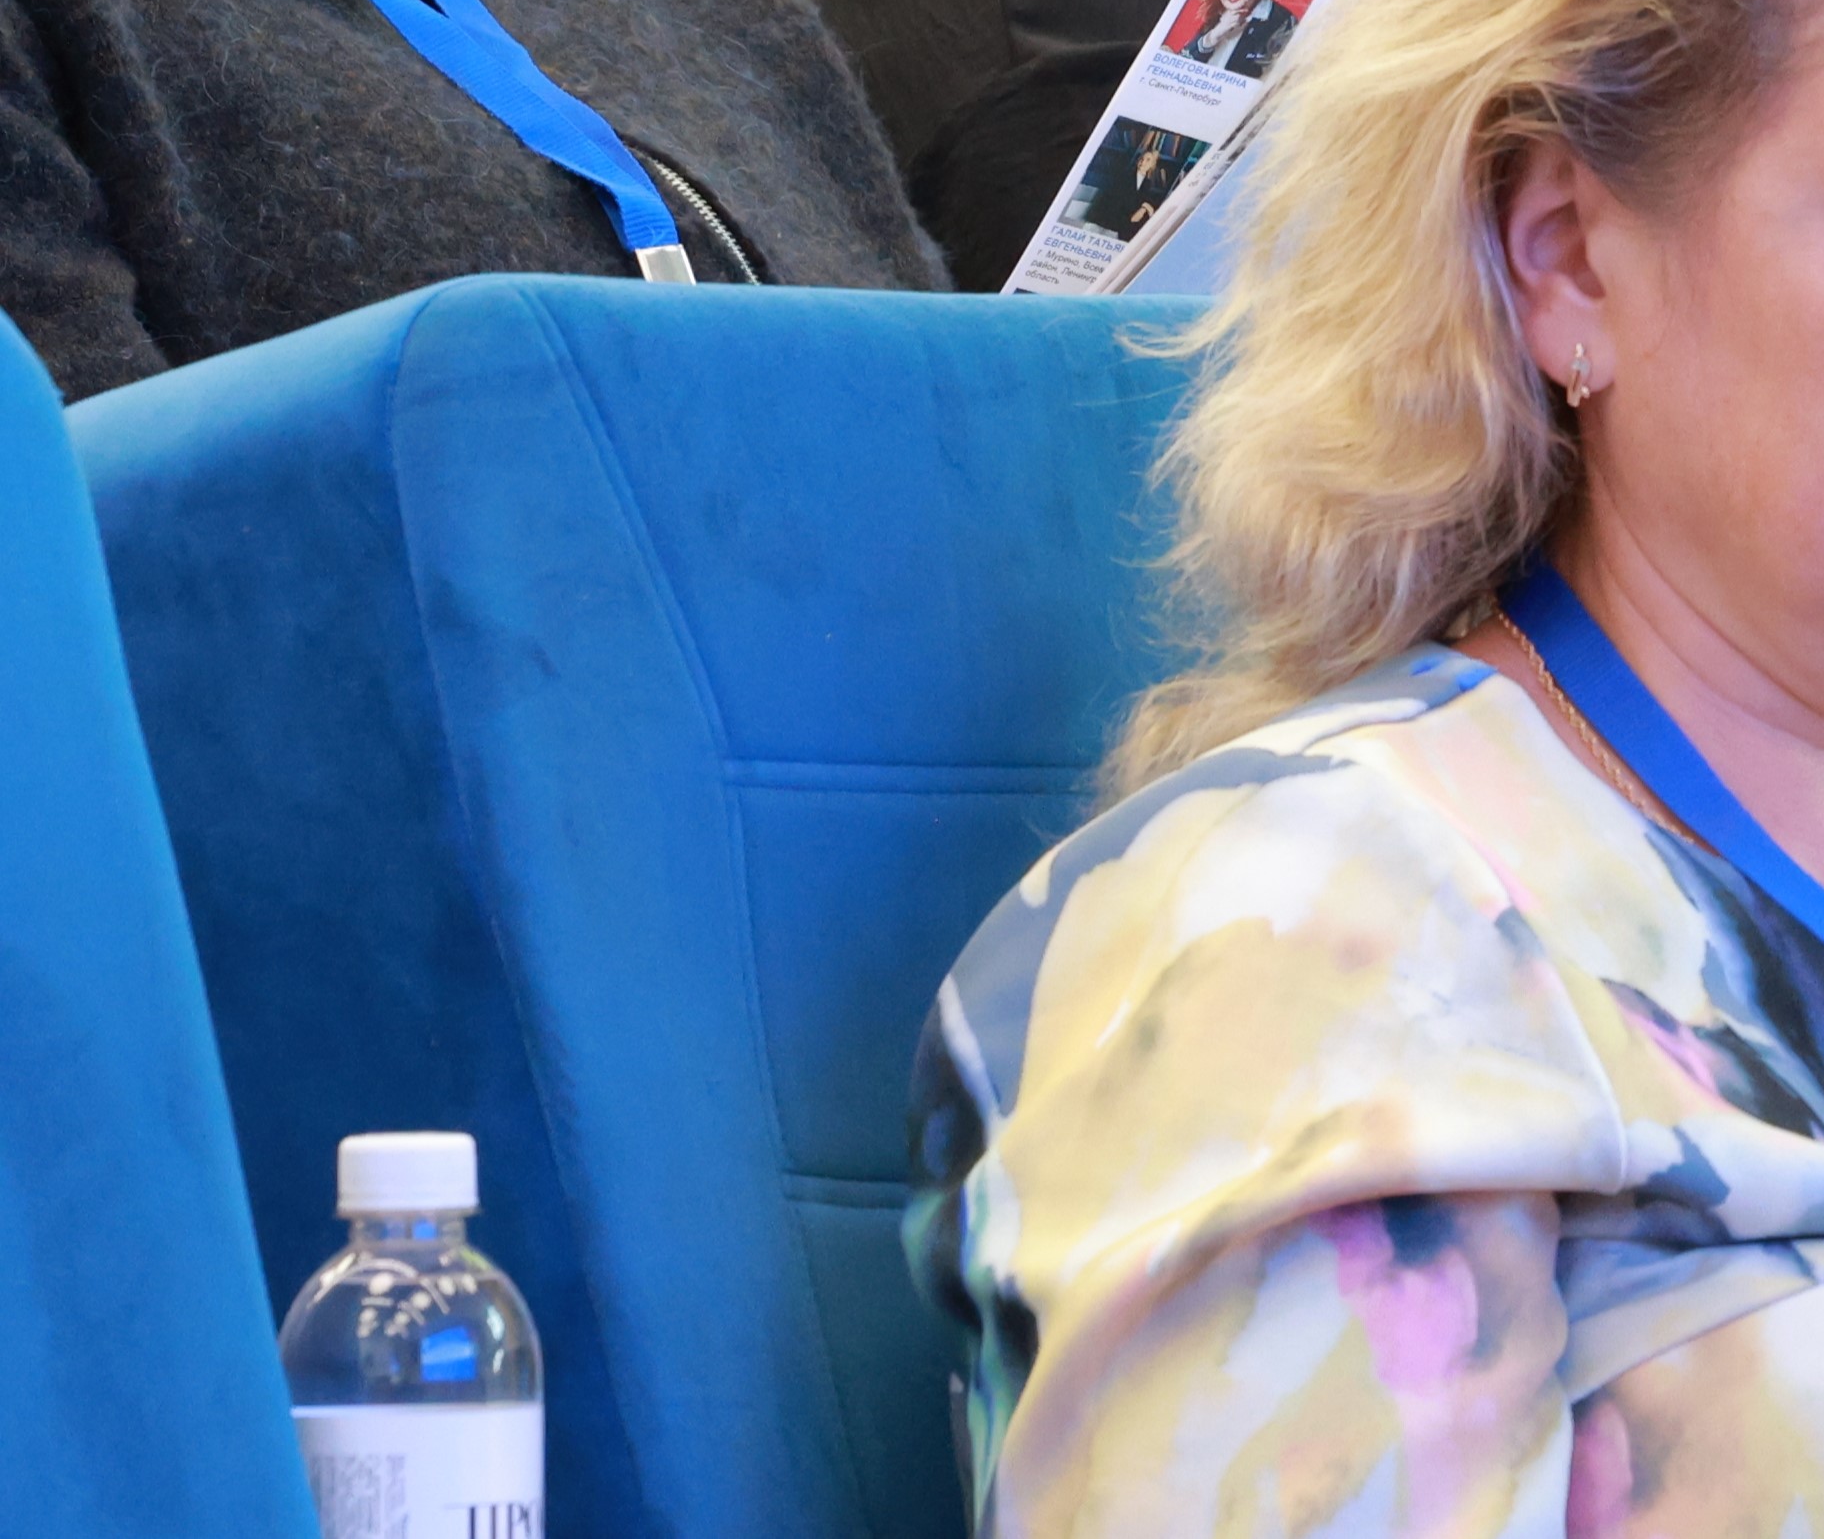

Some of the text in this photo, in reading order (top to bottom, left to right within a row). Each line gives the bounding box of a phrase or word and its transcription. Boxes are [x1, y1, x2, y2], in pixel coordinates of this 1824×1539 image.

[1146, 64, 1222, 94] ГЕННАДЬЕВНА
[1153, 53, 1247, 89] ВОЛЕГОВА ИРИНА
[1148, 78, 1221, 106] Санкт-Петербург
[1051, 225, 1086, 242] ГАЛАЙ
[1044, 237, 1112, 263] ЕВГЕНЬЕВНА
[1025, 270, 1059, 285] область
